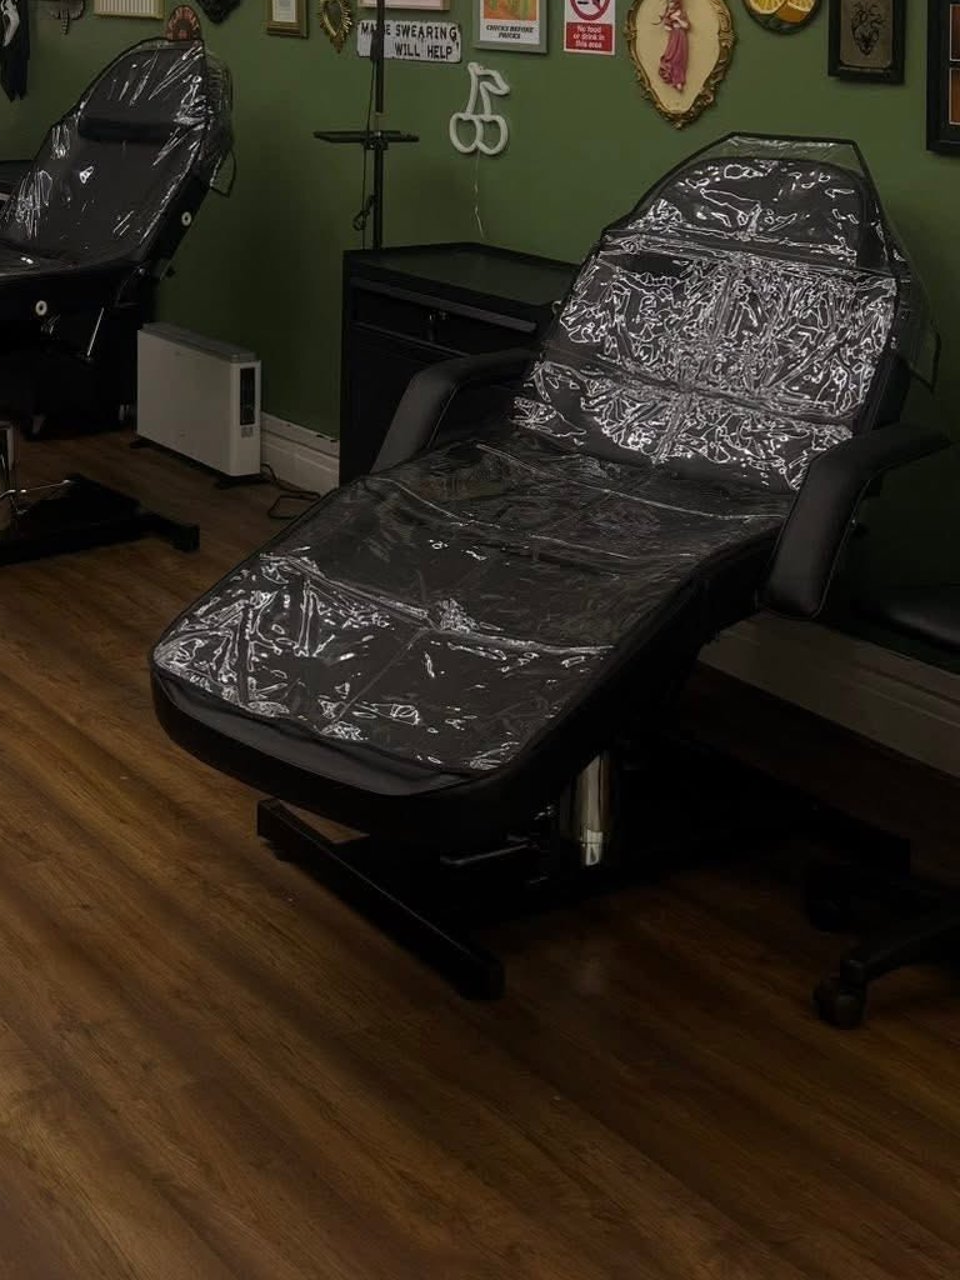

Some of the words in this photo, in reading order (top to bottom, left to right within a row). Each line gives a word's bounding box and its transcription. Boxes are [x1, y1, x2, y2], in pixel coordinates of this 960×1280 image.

[361, 22, 391, 36] MAE
[395, 24, 457, 42] SWEARING
[582, 33, 598, 41] drink
[395, 41, 421, 57] WILL
[427, 44, 453, 60] HELP
[575, 39, 588, 48] this
[588, 41, 603, 49] area
